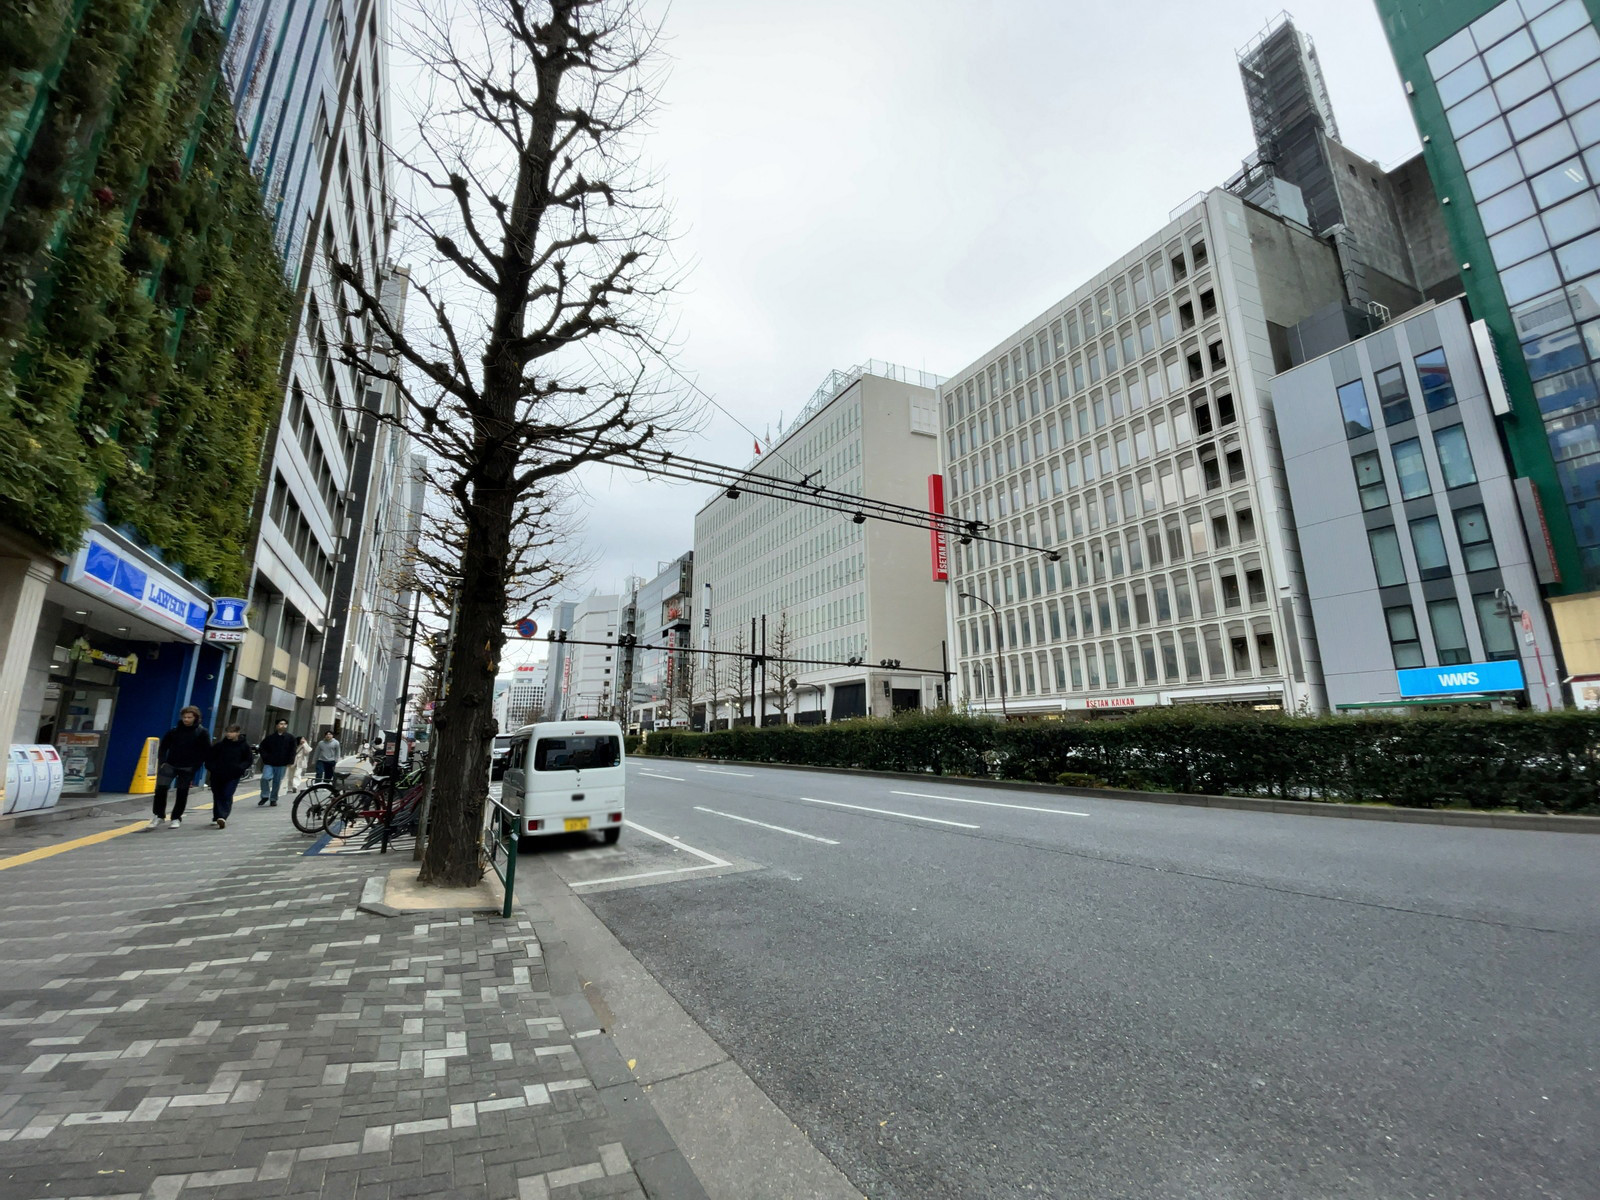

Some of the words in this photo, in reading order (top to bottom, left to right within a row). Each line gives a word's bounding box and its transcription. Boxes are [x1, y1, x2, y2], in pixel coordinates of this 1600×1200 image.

[148, 583, 187, 618] LAWSON
[1438, 671, 1480, 687] WWS
[1111, 698, 1135, 706] KAIKAN
